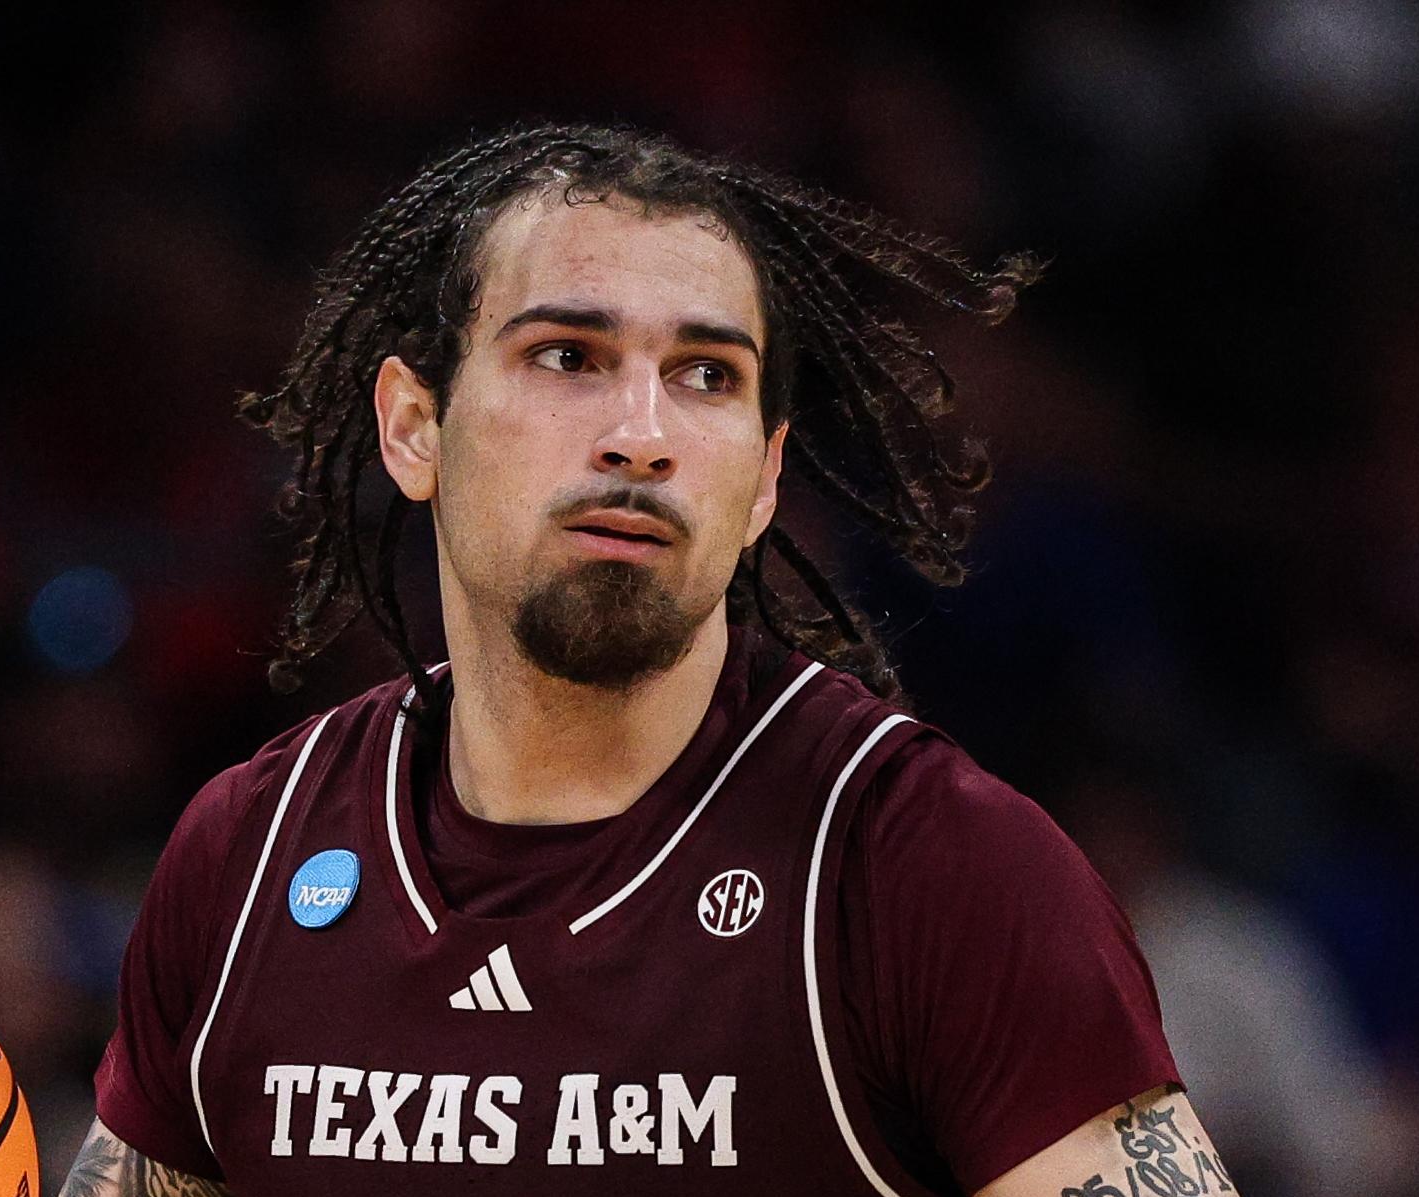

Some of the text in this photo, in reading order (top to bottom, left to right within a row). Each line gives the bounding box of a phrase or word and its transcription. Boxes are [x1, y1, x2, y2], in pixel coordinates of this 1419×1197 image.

[294, 885, 351, 907] NCAA
[702, 873, 761, 932] SEC
[265, 1065, 737, 1166] TEXAS A&M
